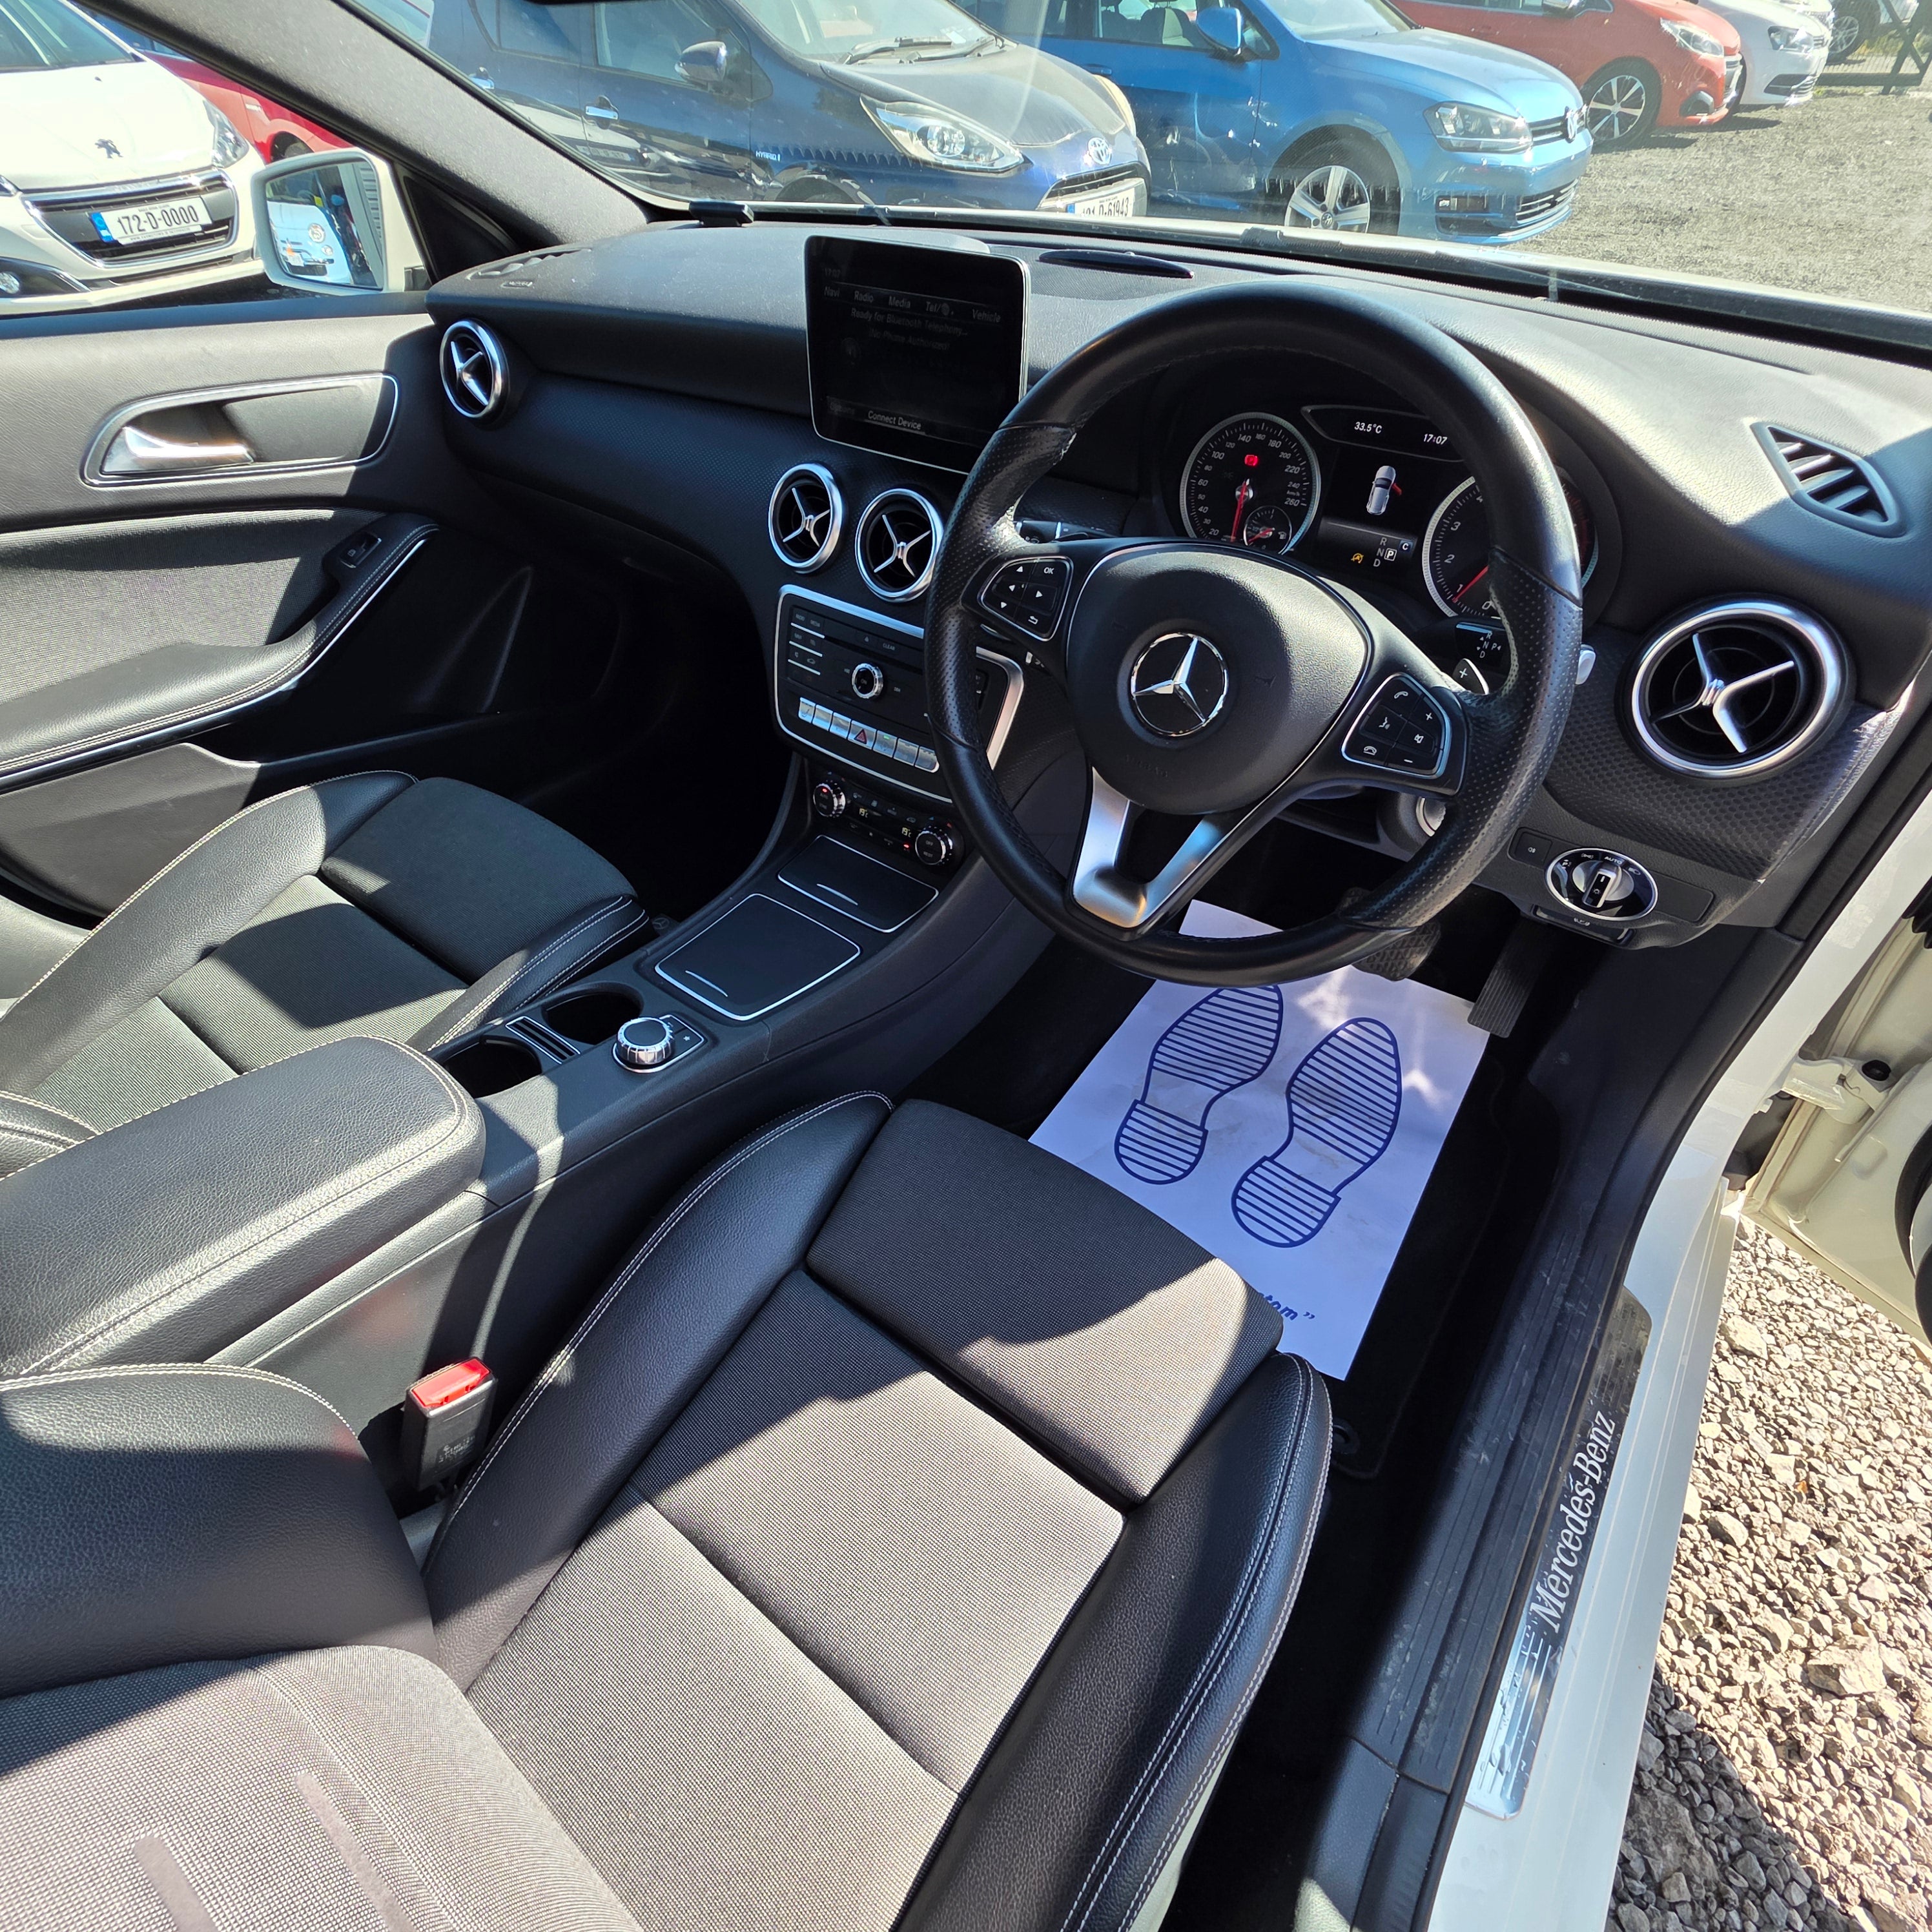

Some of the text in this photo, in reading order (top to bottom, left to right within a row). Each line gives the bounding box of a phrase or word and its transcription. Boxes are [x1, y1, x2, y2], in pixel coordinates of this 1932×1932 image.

[118, 205, 199, 235] 172-D-0000
[854, 291, 874, 303] Radio
[889, 296, 910, 309] Media
[972, 309, 1001, 322] Vehicle
[851, 307, 872, 322] Ready
[874, 311, 885, 322] for
[868, 410, 921, 429] Connect Device
[1354, 422, 1382, 433] 33.5°C
[1238, 434, 1251, 442] 140
[1423, 434, 1447, 445] 17:07
[1268, 439, 1282, 448] 180
[1211, 451, 1224, 460] 100
[1284, 465, 1300, 474] 220
[1284, 498, 1300, 506] 260
[1451, 522, 1461, 531] 3
[1379, 537, 1387, 546] R
[1376, 548, 1394, 559] N P
[1373, 559, 1381, 567] D
[1444, 554, 1455, 563] 2
[1457, 584, 1463, 592] 1
[1486, 631, 1492, 639] R
[1483, 641, 1489, 649] N
[1479, 650, 1485, 659] D
[1604, 856, 1623, 865] AUTO
[1259, 1293, 1298, 1321] tom
[1530, 1411, 1616, 1633] Mercedes-Benz
